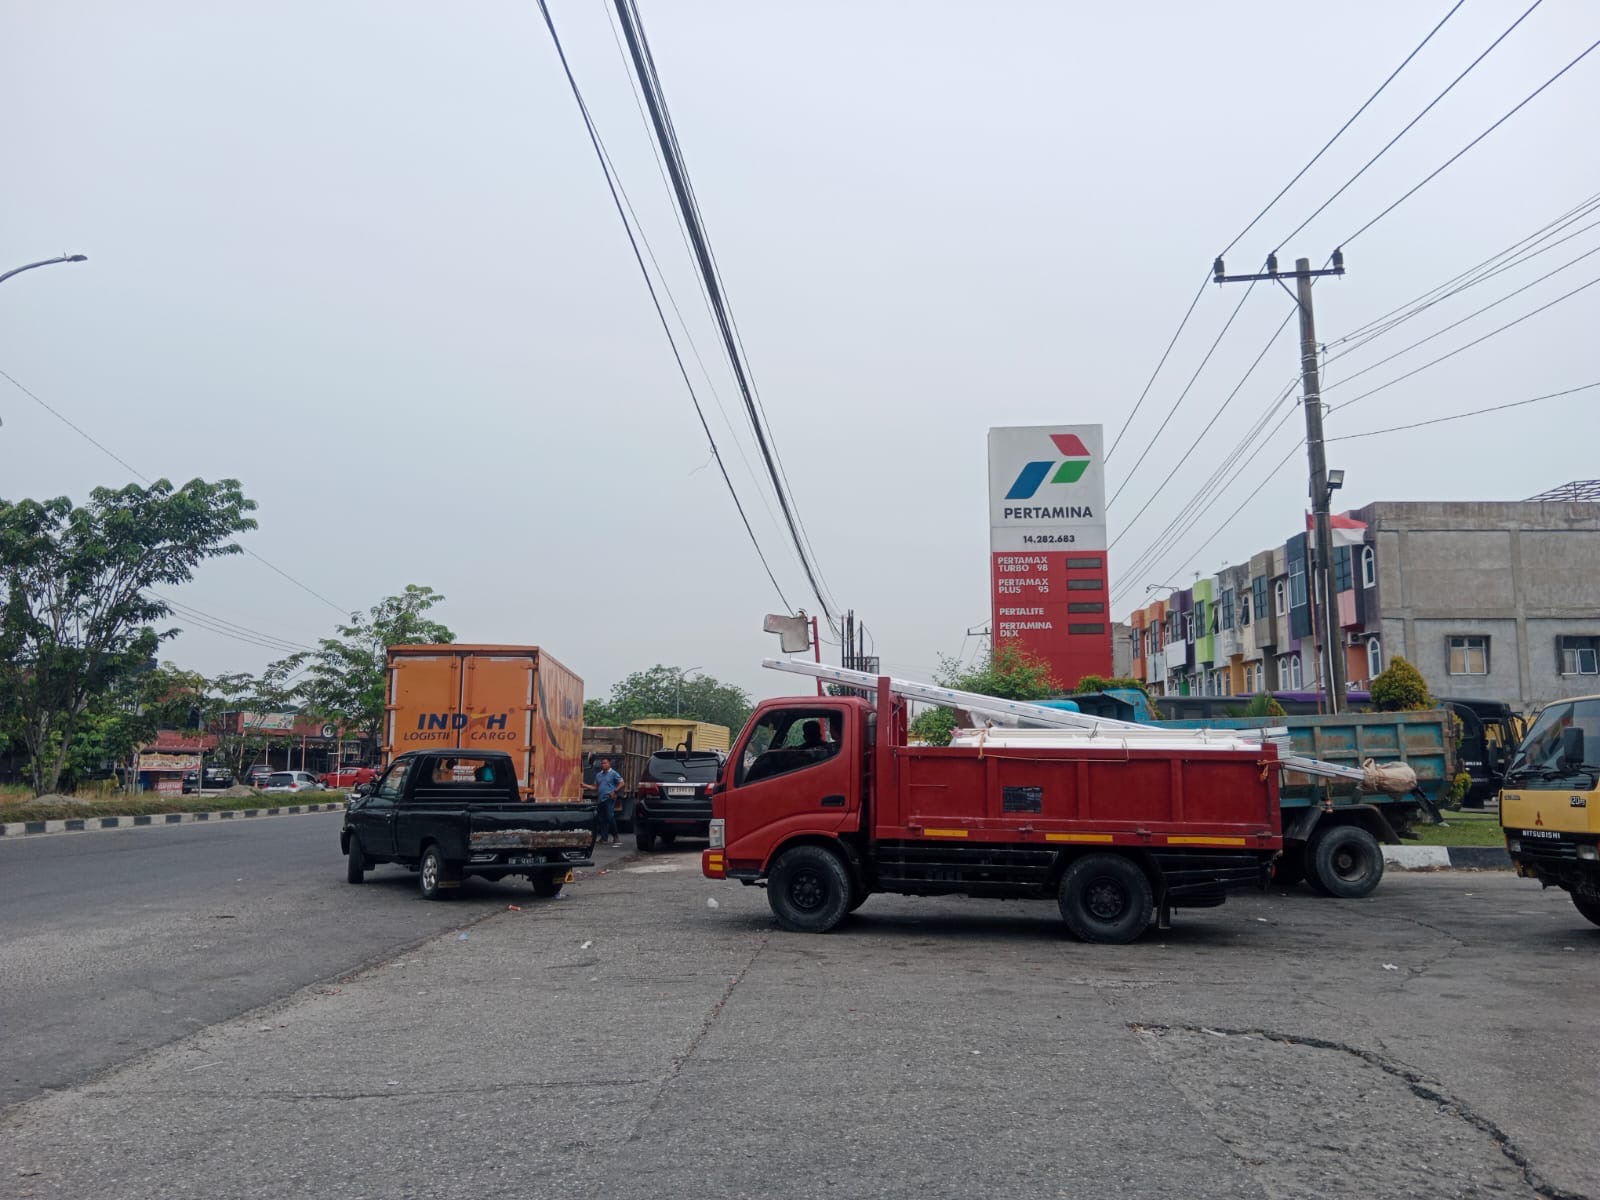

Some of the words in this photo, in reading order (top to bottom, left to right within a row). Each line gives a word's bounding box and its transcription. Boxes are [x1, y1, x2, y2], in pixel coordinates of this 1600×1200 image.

[1004, 506, 1093, 519] PERTAMINA
[1023, 535, 1076, 544] 14.282.683
[998, 556, 1048, 565] PERTAMAX
[999, 564, 1029, 572] TURBO
[1037, 563, 1048, 571] 98
[998, 578, 1048, 586] PERTAMAX
[999, 586, 1021, 594] PLUS
[999, 608, 1044, 616] PERTALITE
[1000, 622, 1052, 630] PERTAMINA
[1000, 630, 1019, 638] DEX
[471, 731, 517, 741] CARGO
[1522, 830, 1561, 839] MITSUBISHI
